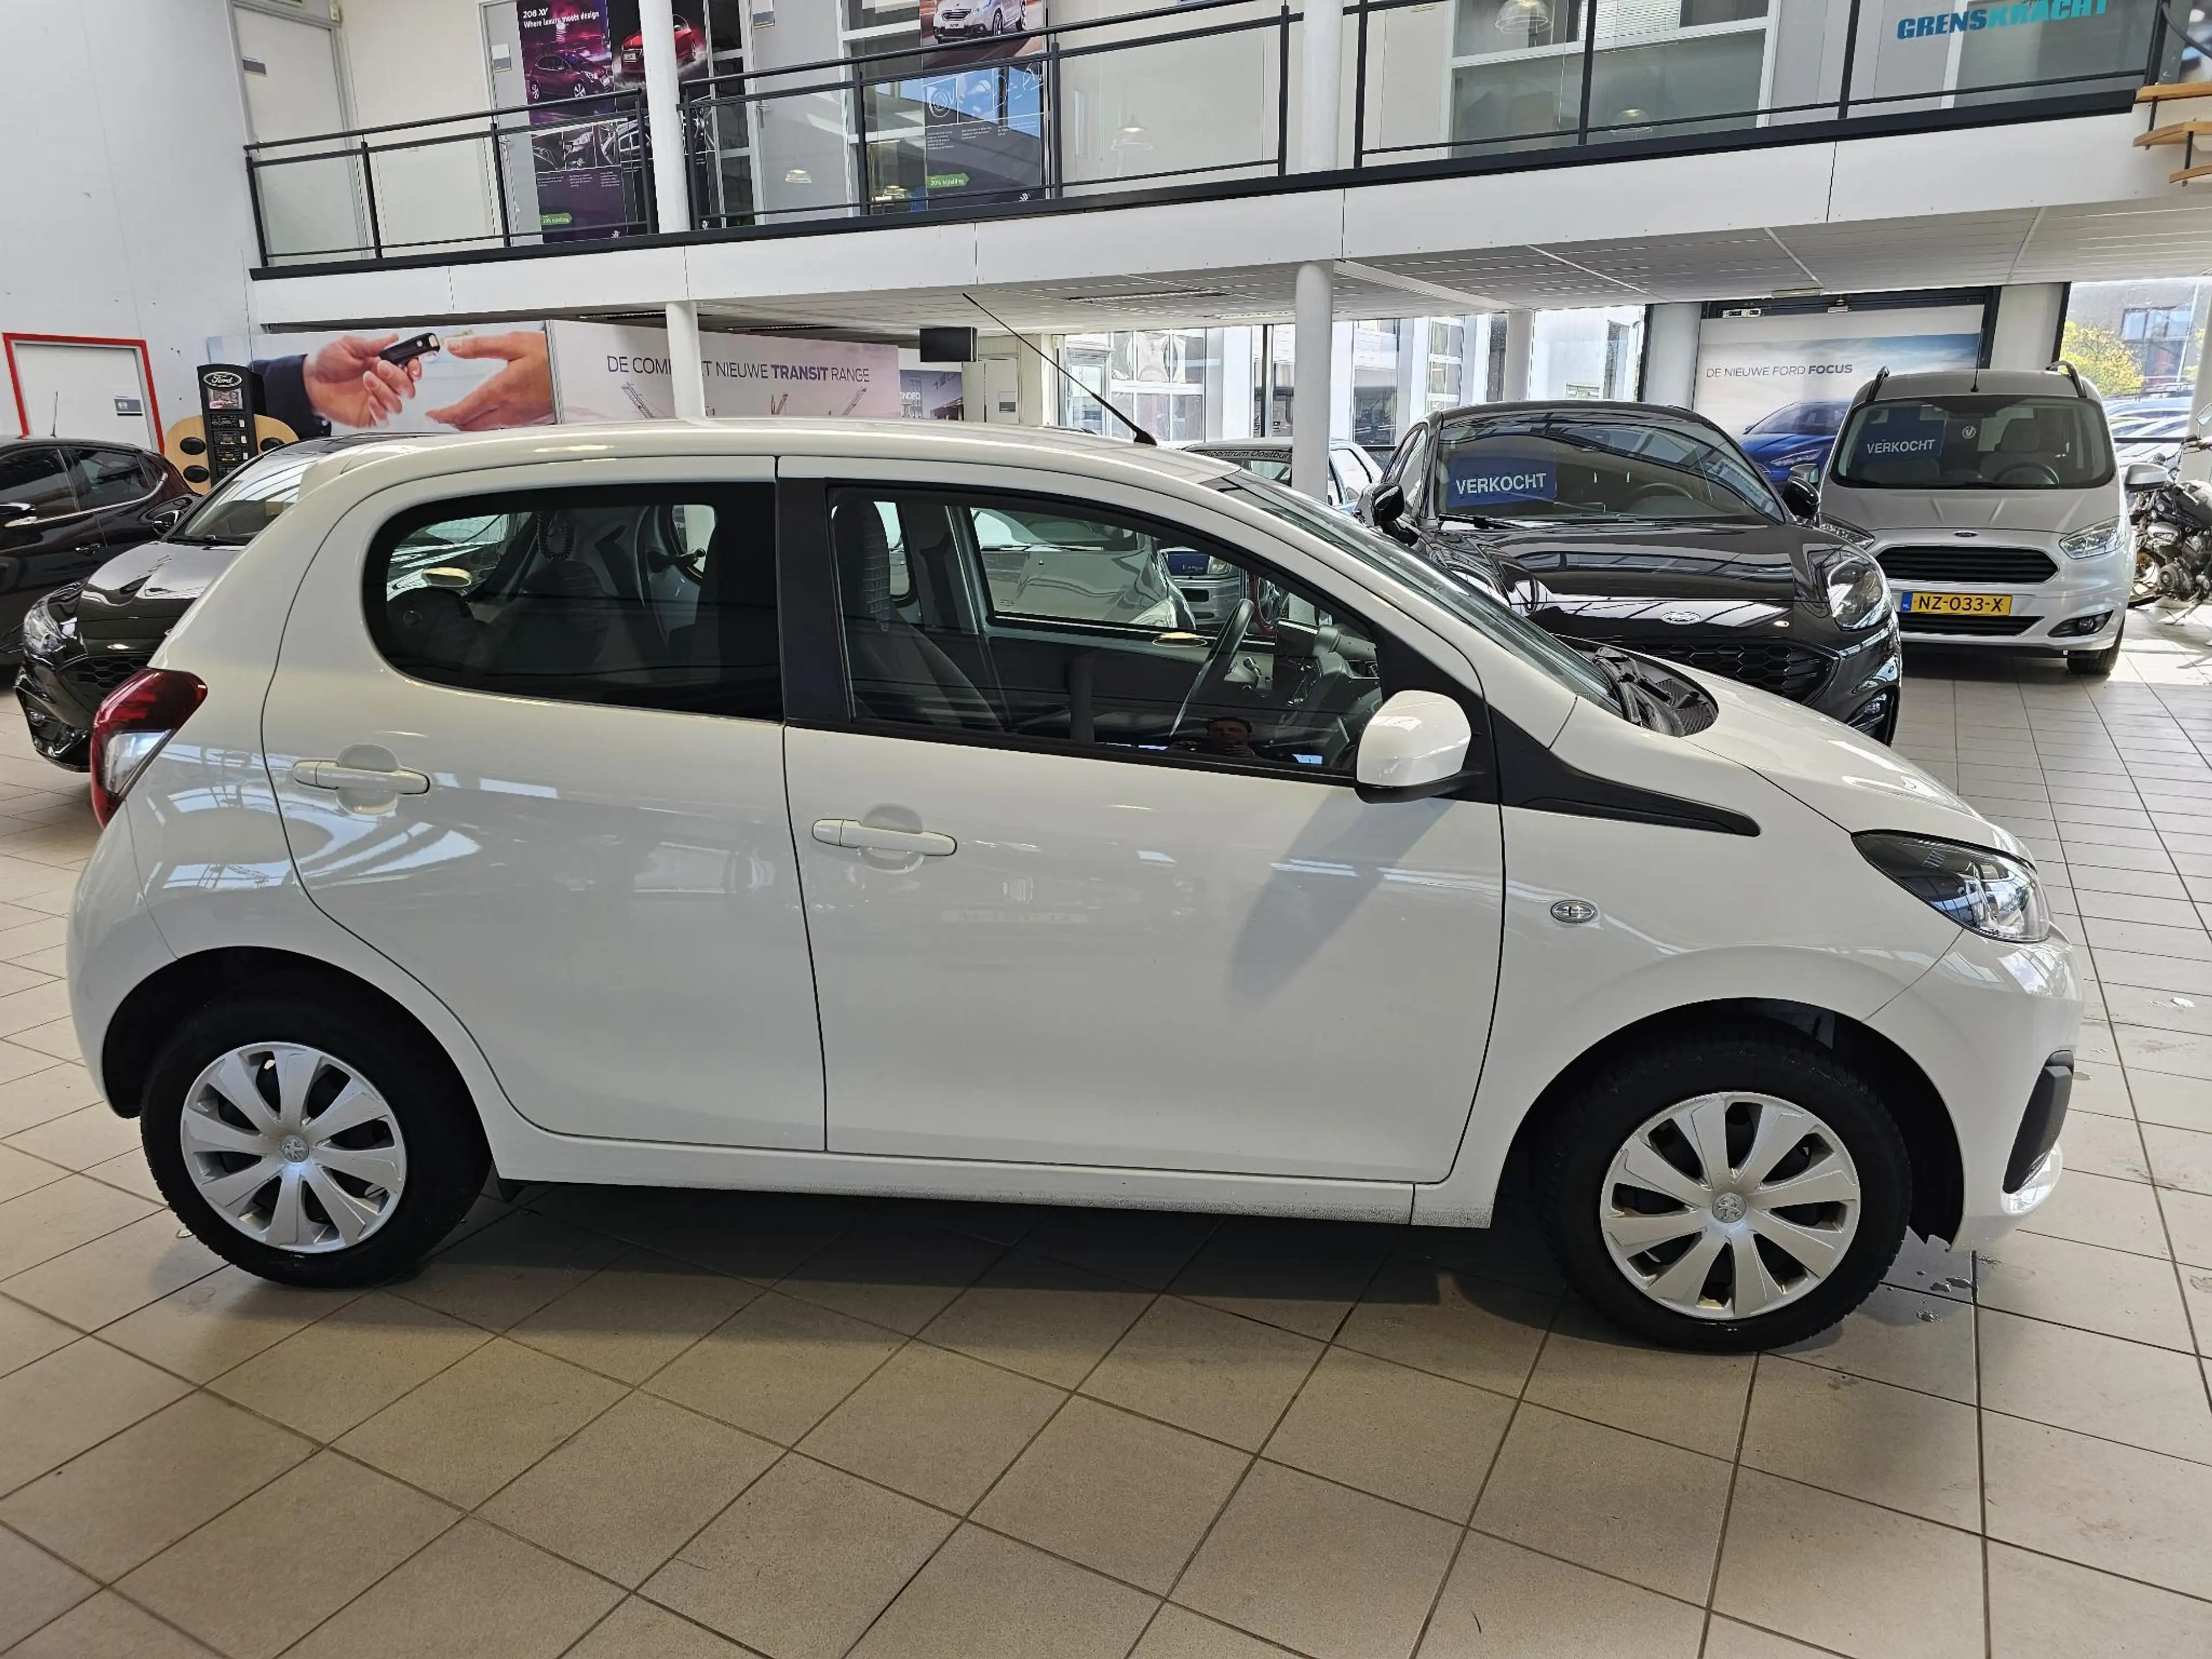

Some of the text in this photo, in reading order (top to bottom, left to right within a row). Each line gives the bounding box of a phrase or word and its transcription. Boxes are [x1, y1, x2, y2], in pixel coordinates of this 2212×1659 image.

[522, 7, 548, 18] 208 XY
[524, 20, 542, 28] Where
[580, 11, 600, 20] design
[607, 355, 629, 373] DE
[716, 362, 768, 378] NIEUWE
[771, 365, 828, 381] TRANSIT
[831, 367, 870, 382] RANGE
[1706, 364, 1853, 378] DE NIEUWE FORD FOCUS
[211, 374, 233, 384] Ford
[1867, 439, 1936, 454] VERKOCHT
[1456, 473, 1547, 494] VERKOCHT
[1918, 596, 2003, 612] NZ-033-X
